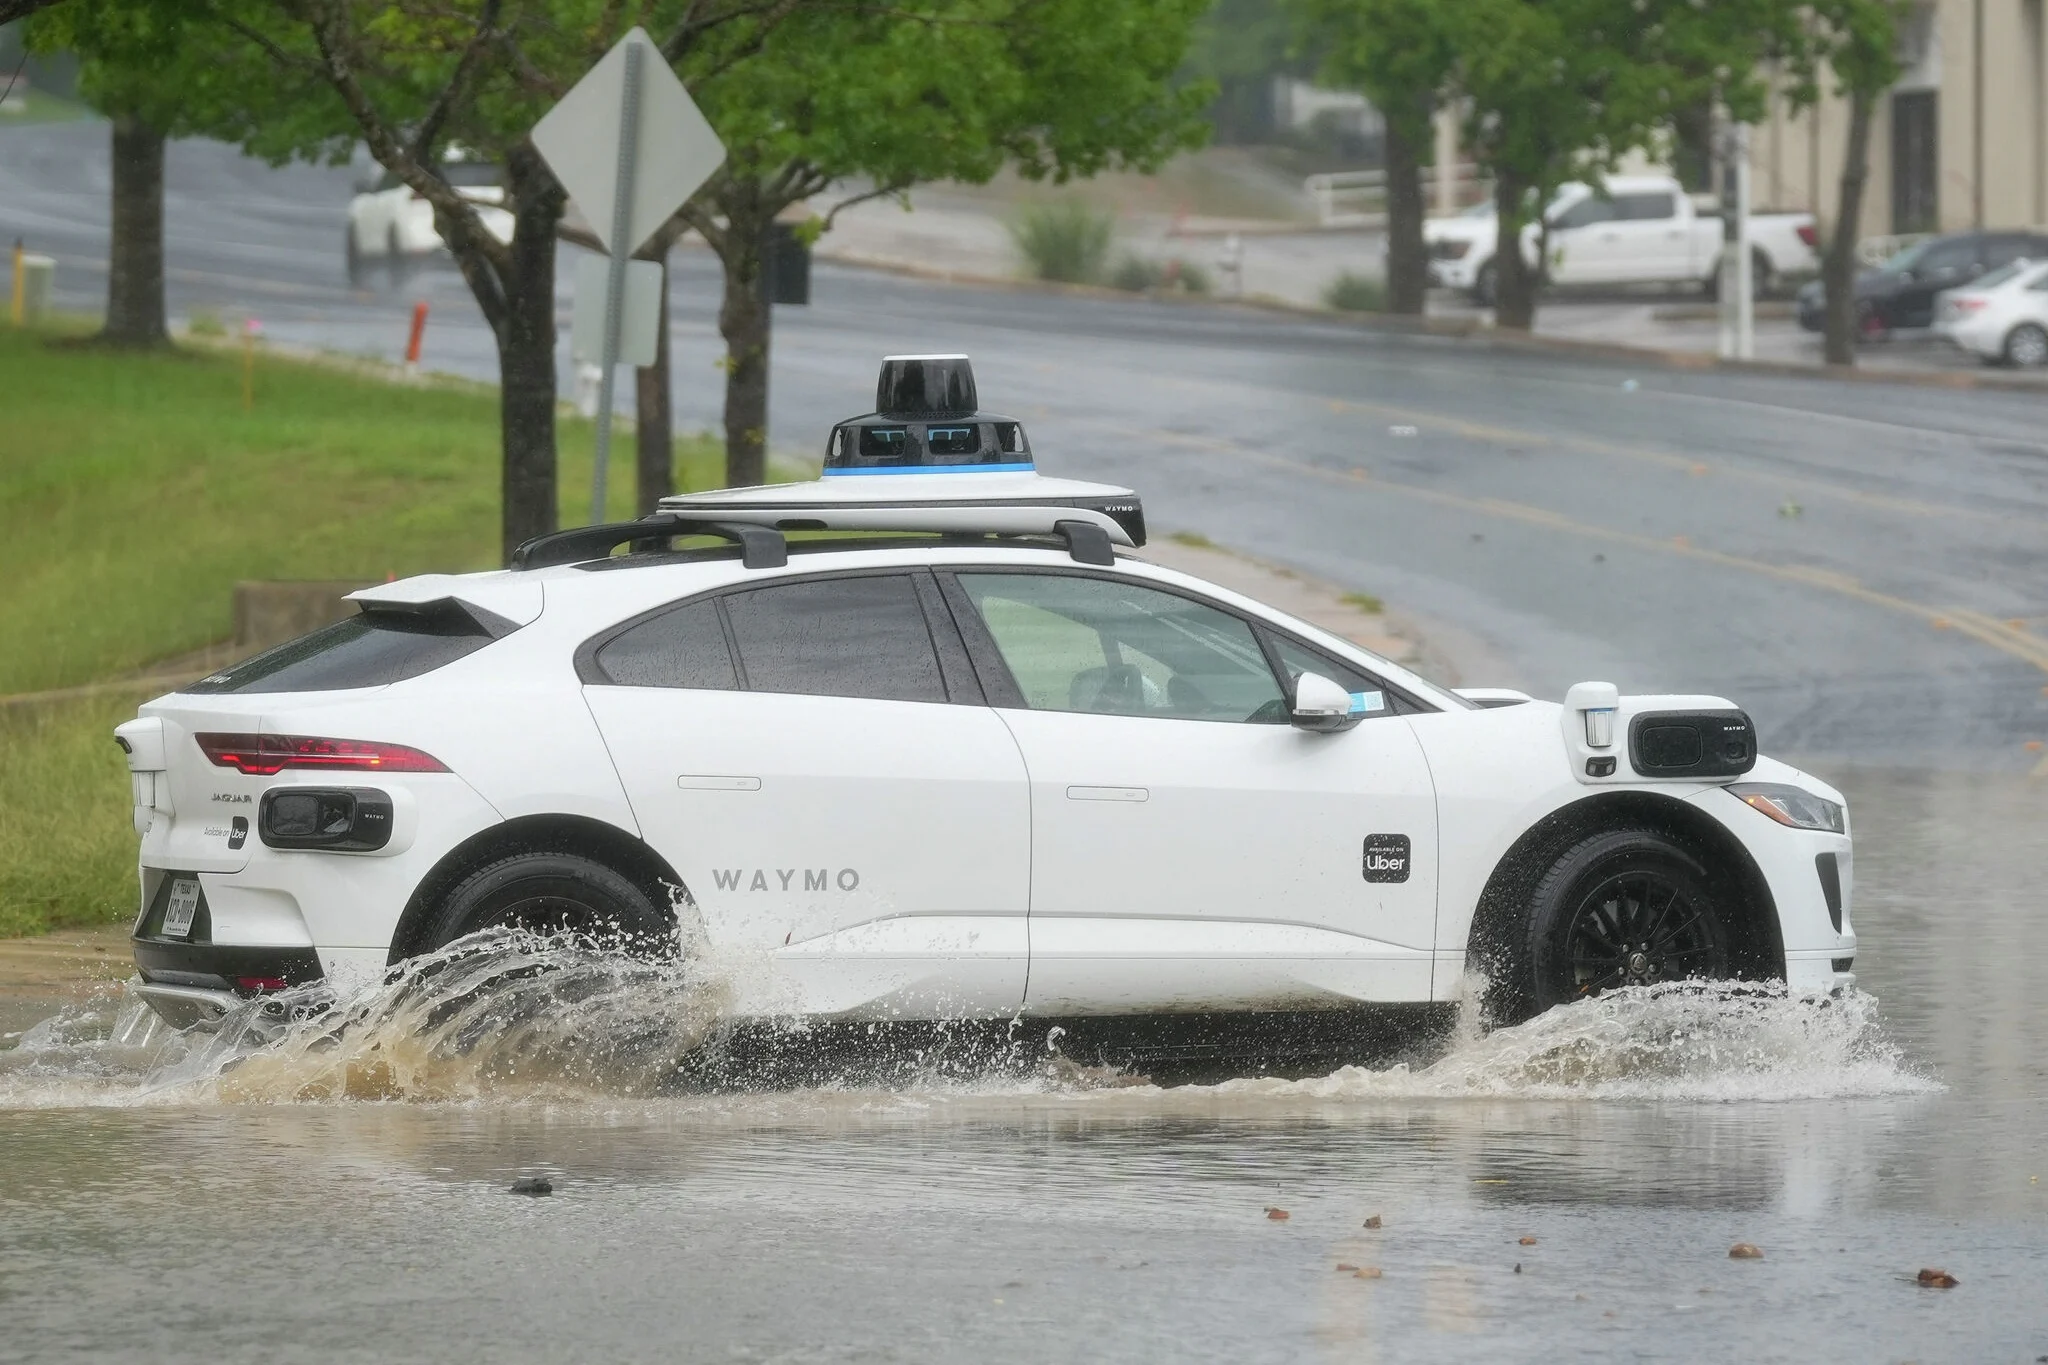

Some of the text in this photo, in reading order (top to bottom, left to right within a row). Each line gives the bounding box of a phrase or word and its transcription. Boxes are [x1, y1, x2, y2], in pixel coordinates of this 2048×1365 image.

[211, 792, 252, 804] JAGUAR
[231, 828, 247, 839] Uber
[1366, 855, 1406, 870] Uber
[711, 868, 860, 892] WAYMO
